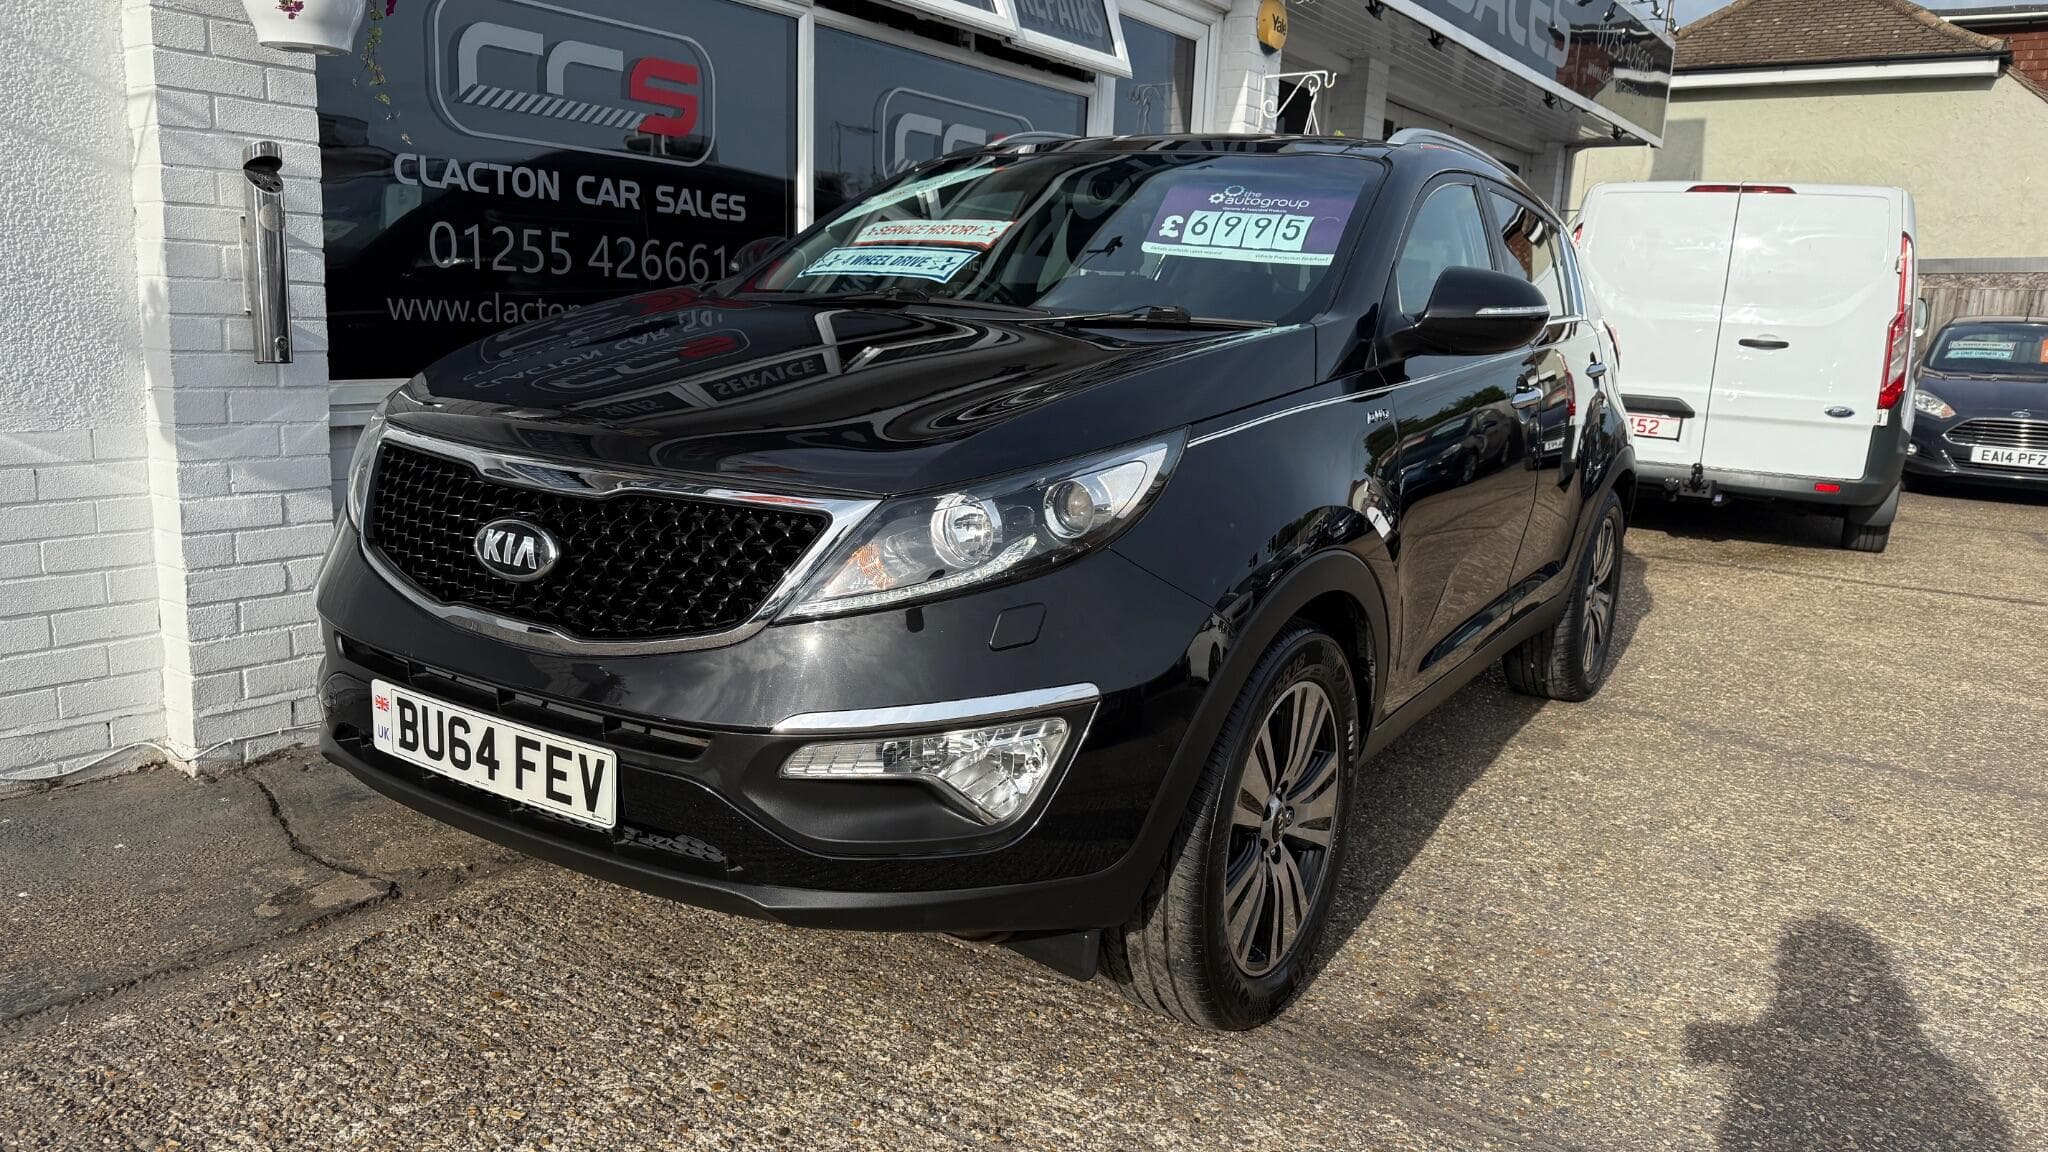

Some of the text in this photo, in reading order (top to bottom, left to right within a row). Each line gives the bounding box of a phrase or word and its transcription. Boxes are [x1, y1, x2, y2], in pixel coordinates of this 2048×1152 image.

[1272, 13, 1287, 36] Yale
[1446, 0, 1571, 68] LES
[457, 21, 701, 138] CCS
[393, 153, 747, 223] CLACTON CAR SALES
[1224, 196, 1311, 210] autogroup
[879, 224, 982, 236] SERVICE HISTORY
[428, 220, 729, 283] 01255 426661
[850, 254, 891, 267] WHEEL
[888, 255, 934, 268] DRIVE
[1630, 417, 1660, 435] 52
[1981, 449, 2048, 466] EA14 PFZ
[482, 528, 538, 570] KIA
[377, 724, 390, 741] UK
[396, 696, 606, 813] BU64 FEV
